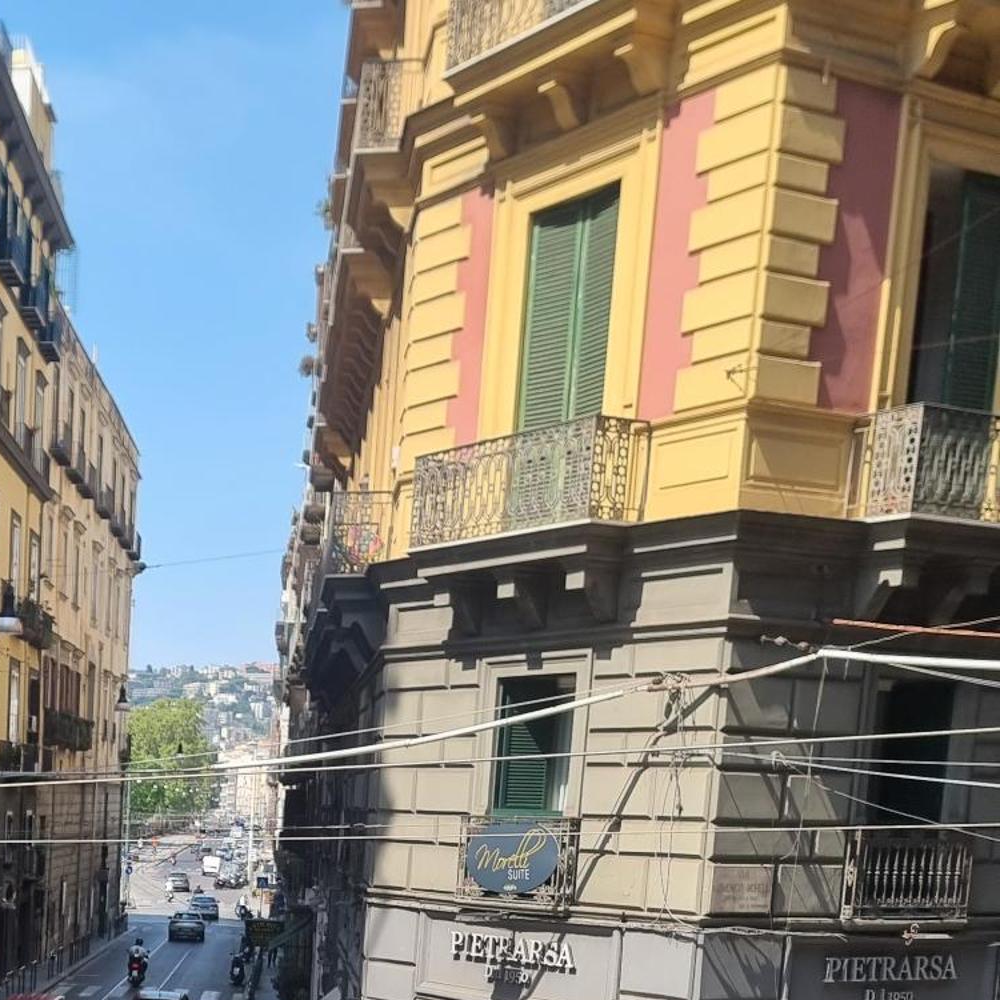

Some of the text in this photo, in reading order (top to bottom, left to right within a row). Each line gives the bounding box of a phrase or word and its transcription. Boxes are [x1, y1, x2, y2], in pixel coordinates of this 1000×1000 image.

[474, 825, 547, 872] Morelli
[507, 868, 530, 881] SUITE
[450, 930, 574, 969] PIETRARSA
[824, 953, 957, 983] PIETRARSA
